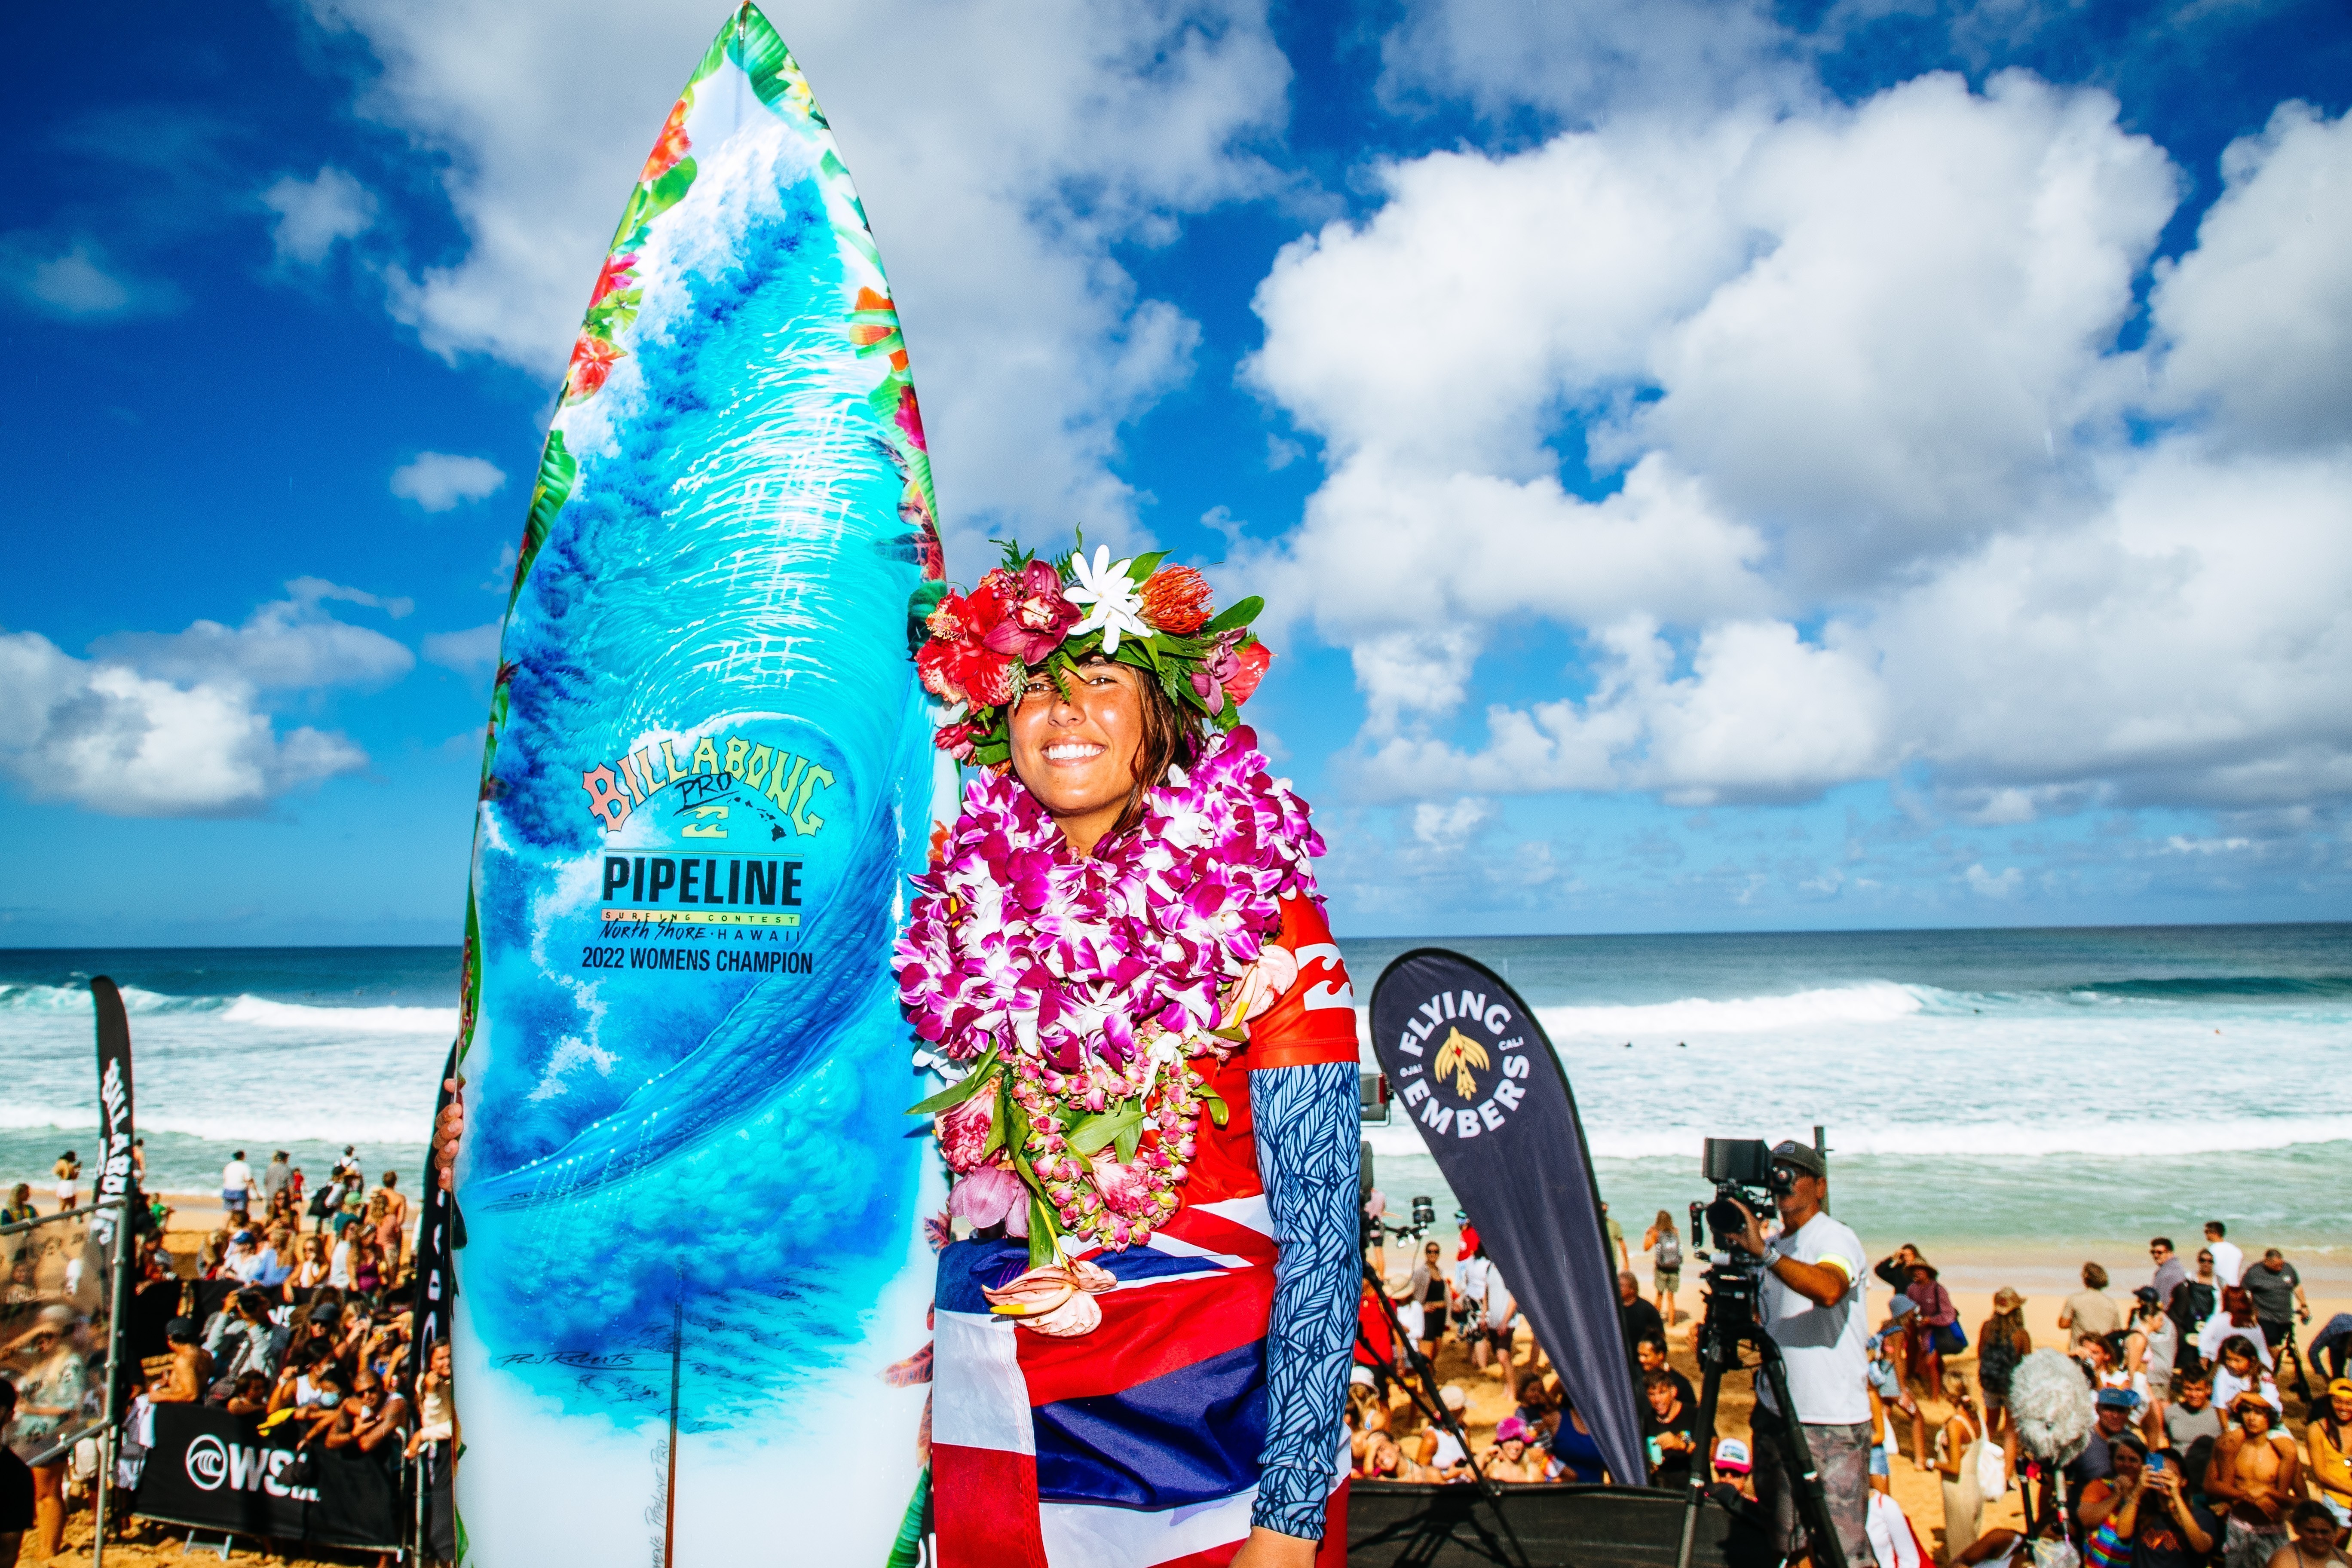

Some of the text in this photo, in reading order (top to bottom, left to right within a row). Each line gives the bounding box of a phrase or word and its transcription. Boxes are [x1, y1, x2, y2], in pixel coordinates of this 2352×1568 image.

[582, 735, 836, 837] BILLABONG
[674, 772, 732, 806] PRO
[603, 857, 803, 906] PIPELINE
[606, 912, 795, 924] SURFING CONTEST
[718, 929, 799, 942] HAWAII
[582, 946, 813, 974] 2022 WOMENS CHAMPION
[1400, 989, 1512, 1057] FLYING
[1403, 1055, 1530, 1139] EMBERS
[651, 1439, 669, 1468] PRO
